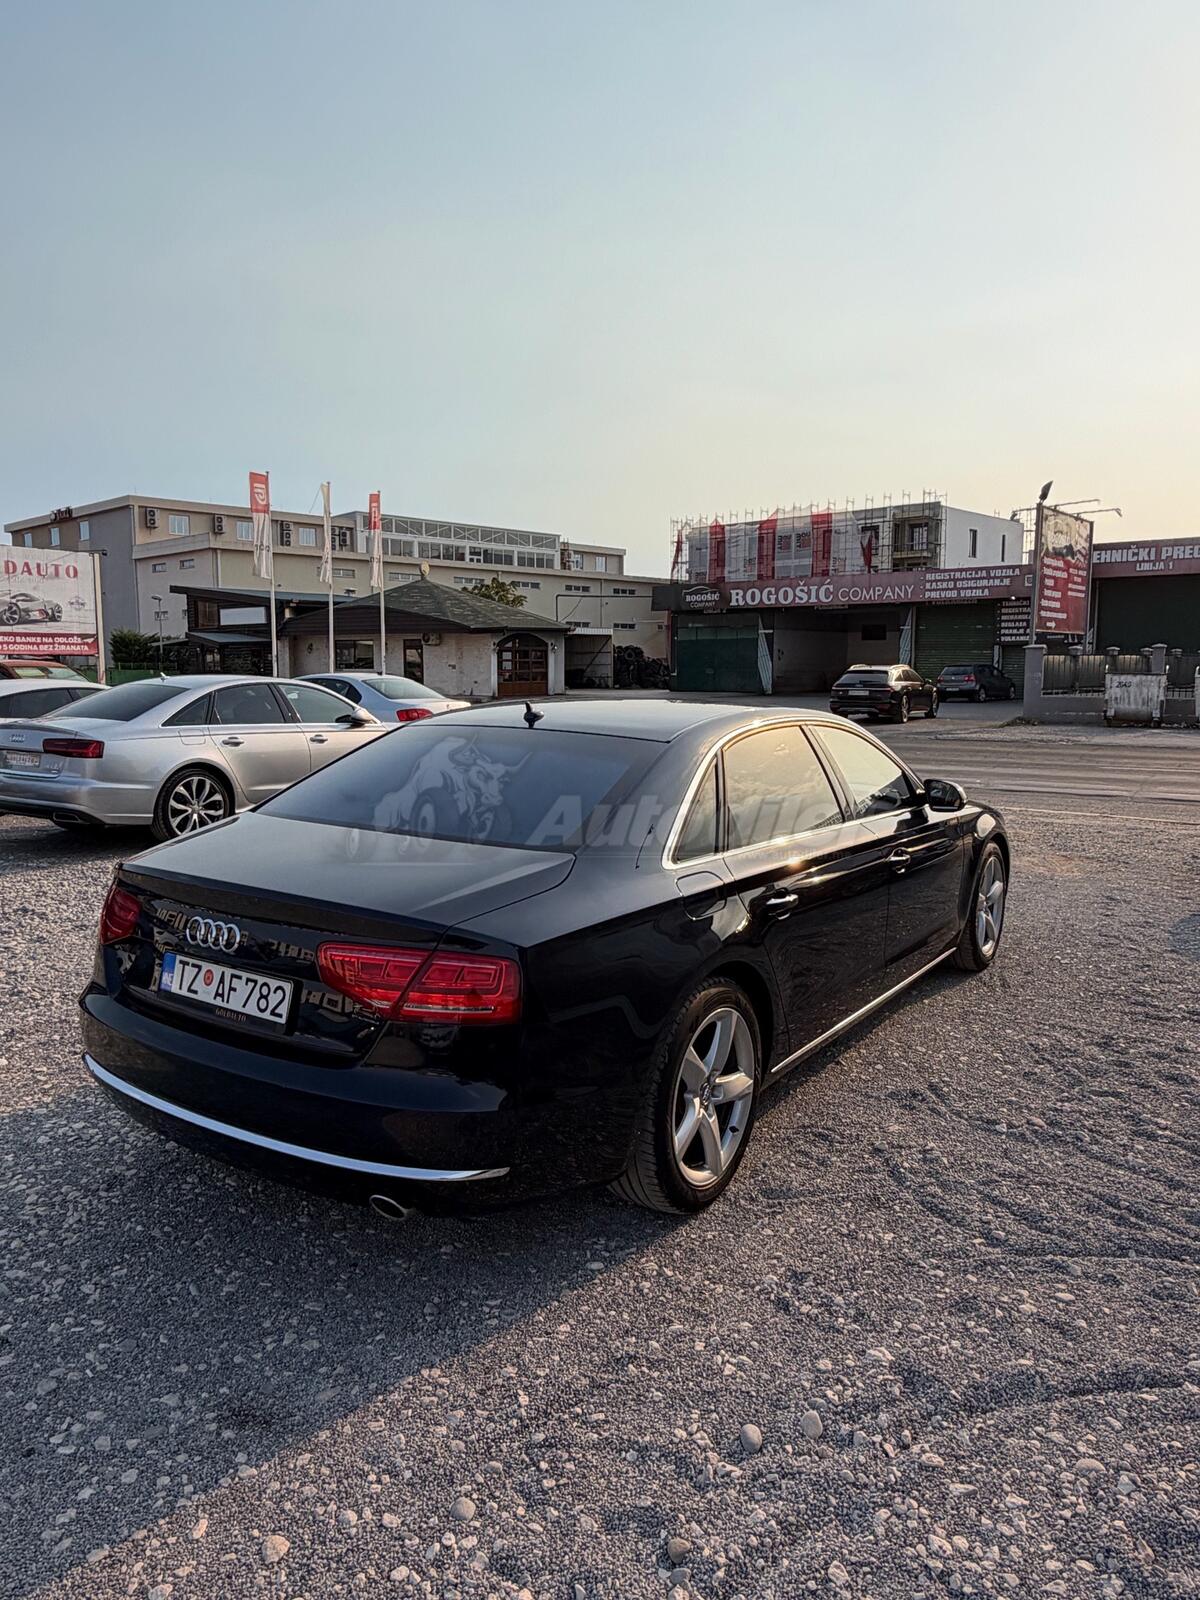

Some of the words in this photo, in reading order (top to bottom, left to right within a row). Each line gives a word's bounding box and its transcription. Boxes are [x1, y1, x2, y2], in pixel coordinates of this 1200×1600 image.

[1092, 545, 1156, 563] EHNIČKI
[1136, 562, 1165, 571] LINIJA
[1168, 561, 1173, 570] 1
[926, 570, 987, 580] REGISTRACIJA
[990, 568, 1020, 577] VOZILA
[925, 581, 954, 589] KASKO
[956, 578, 1011, 588] OSIGURANJE
[685, 592, 720, 602] ROGOŠIĆ
[729, 579, 834, 606] ROGOŠIĆ
[838, 585, 914, 601] COMPANY
[925, 590, 957, 598] PREVOD
[960, 588, 989, 597] VOZILA
[178, 959, 203, 995] TZ
[213, 970, 288, 1019] AF782
